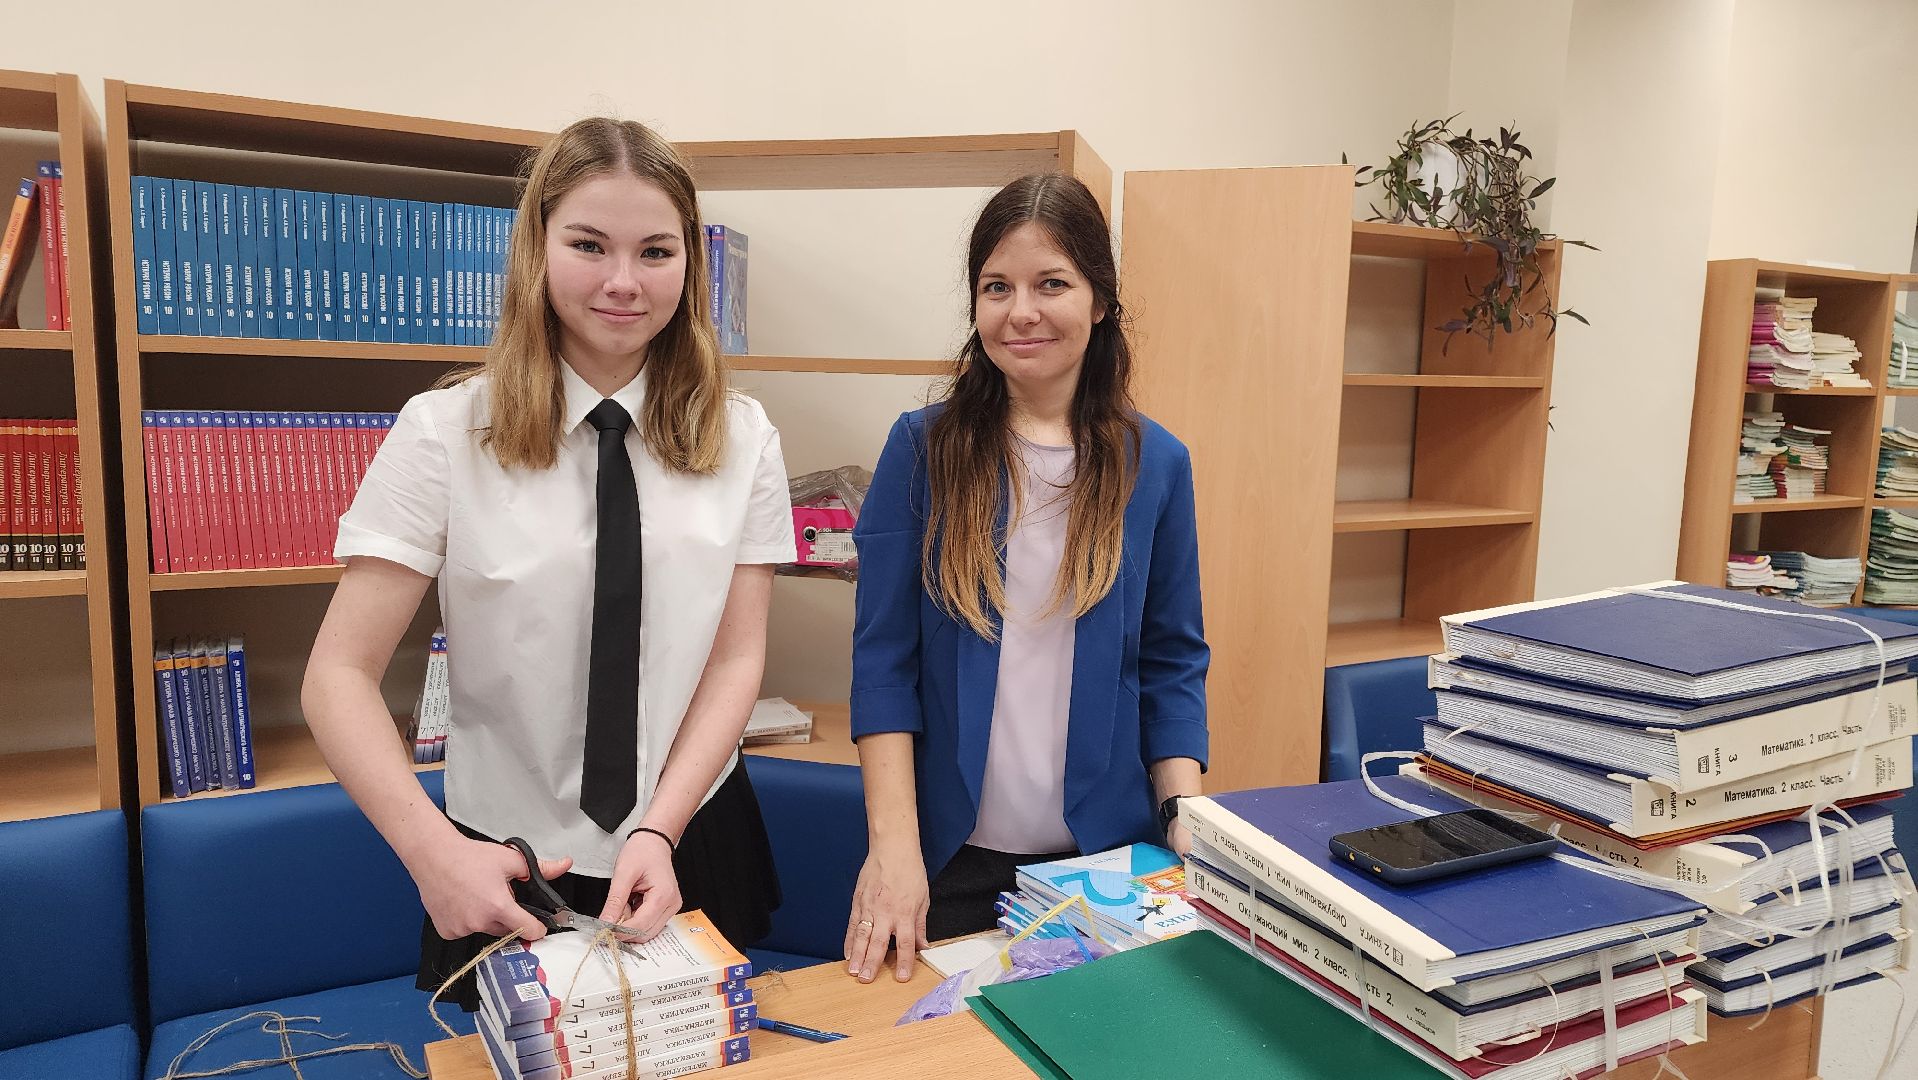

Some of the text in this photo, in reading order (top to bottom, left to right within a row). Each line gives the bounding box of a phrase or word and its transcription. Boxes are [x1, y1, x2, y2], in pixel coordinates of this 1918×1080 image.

[144, 306, 152, 314] 10
[164, 306, 172, 314] 10
[227, 309, 234, 317] 10
[245, 310, 254, 318] 10
[266, 311, 273, 319] 10
[416, 318, 423, 326] 10
[14, 544, 27, 553] 10
[29, 544, 42, 553] 10
[44, 545, 56, 553] 10
[61, 544, 73, 552] 10
[1761, 738, 1806, 757] Математика.
[1810, 734, 1814, 745] 2
[1729, 754, 1737, 762] 3
[1724, 775, 1843, 803] Математика. 2 класс. Часть
[1685, 798, 1696, 807] 2
[1221, 836, 1239, 857] Часть
[1243, 850, 1264, 872] класс.
[1633, 856, 1643, 869] 2.
[1267, 866, 1271, 877] 1
[1274, 871, 1291, 888] мир.
[1048, 871, 1137, 907] 2
[1295, 884, 1347, 928] Окружающий
[1207, 882, 1210, 892] 1
[1293, 936, 1309, 954] мир.
[1315, 948, 1319, 960] 2
[1323, 955, 1349, 979] класс.
[1386, 992, 1394, 1007] 2.
[1384, 943, 1390, 957] 2
[572, 999, 585, 1008] 7
[566, 1015, 578, 1024] 7
[575, 1030, 587, 1039] 7
[579, 1045, 592, 1054] 7
[582, 1061, 595, 1069] 7
